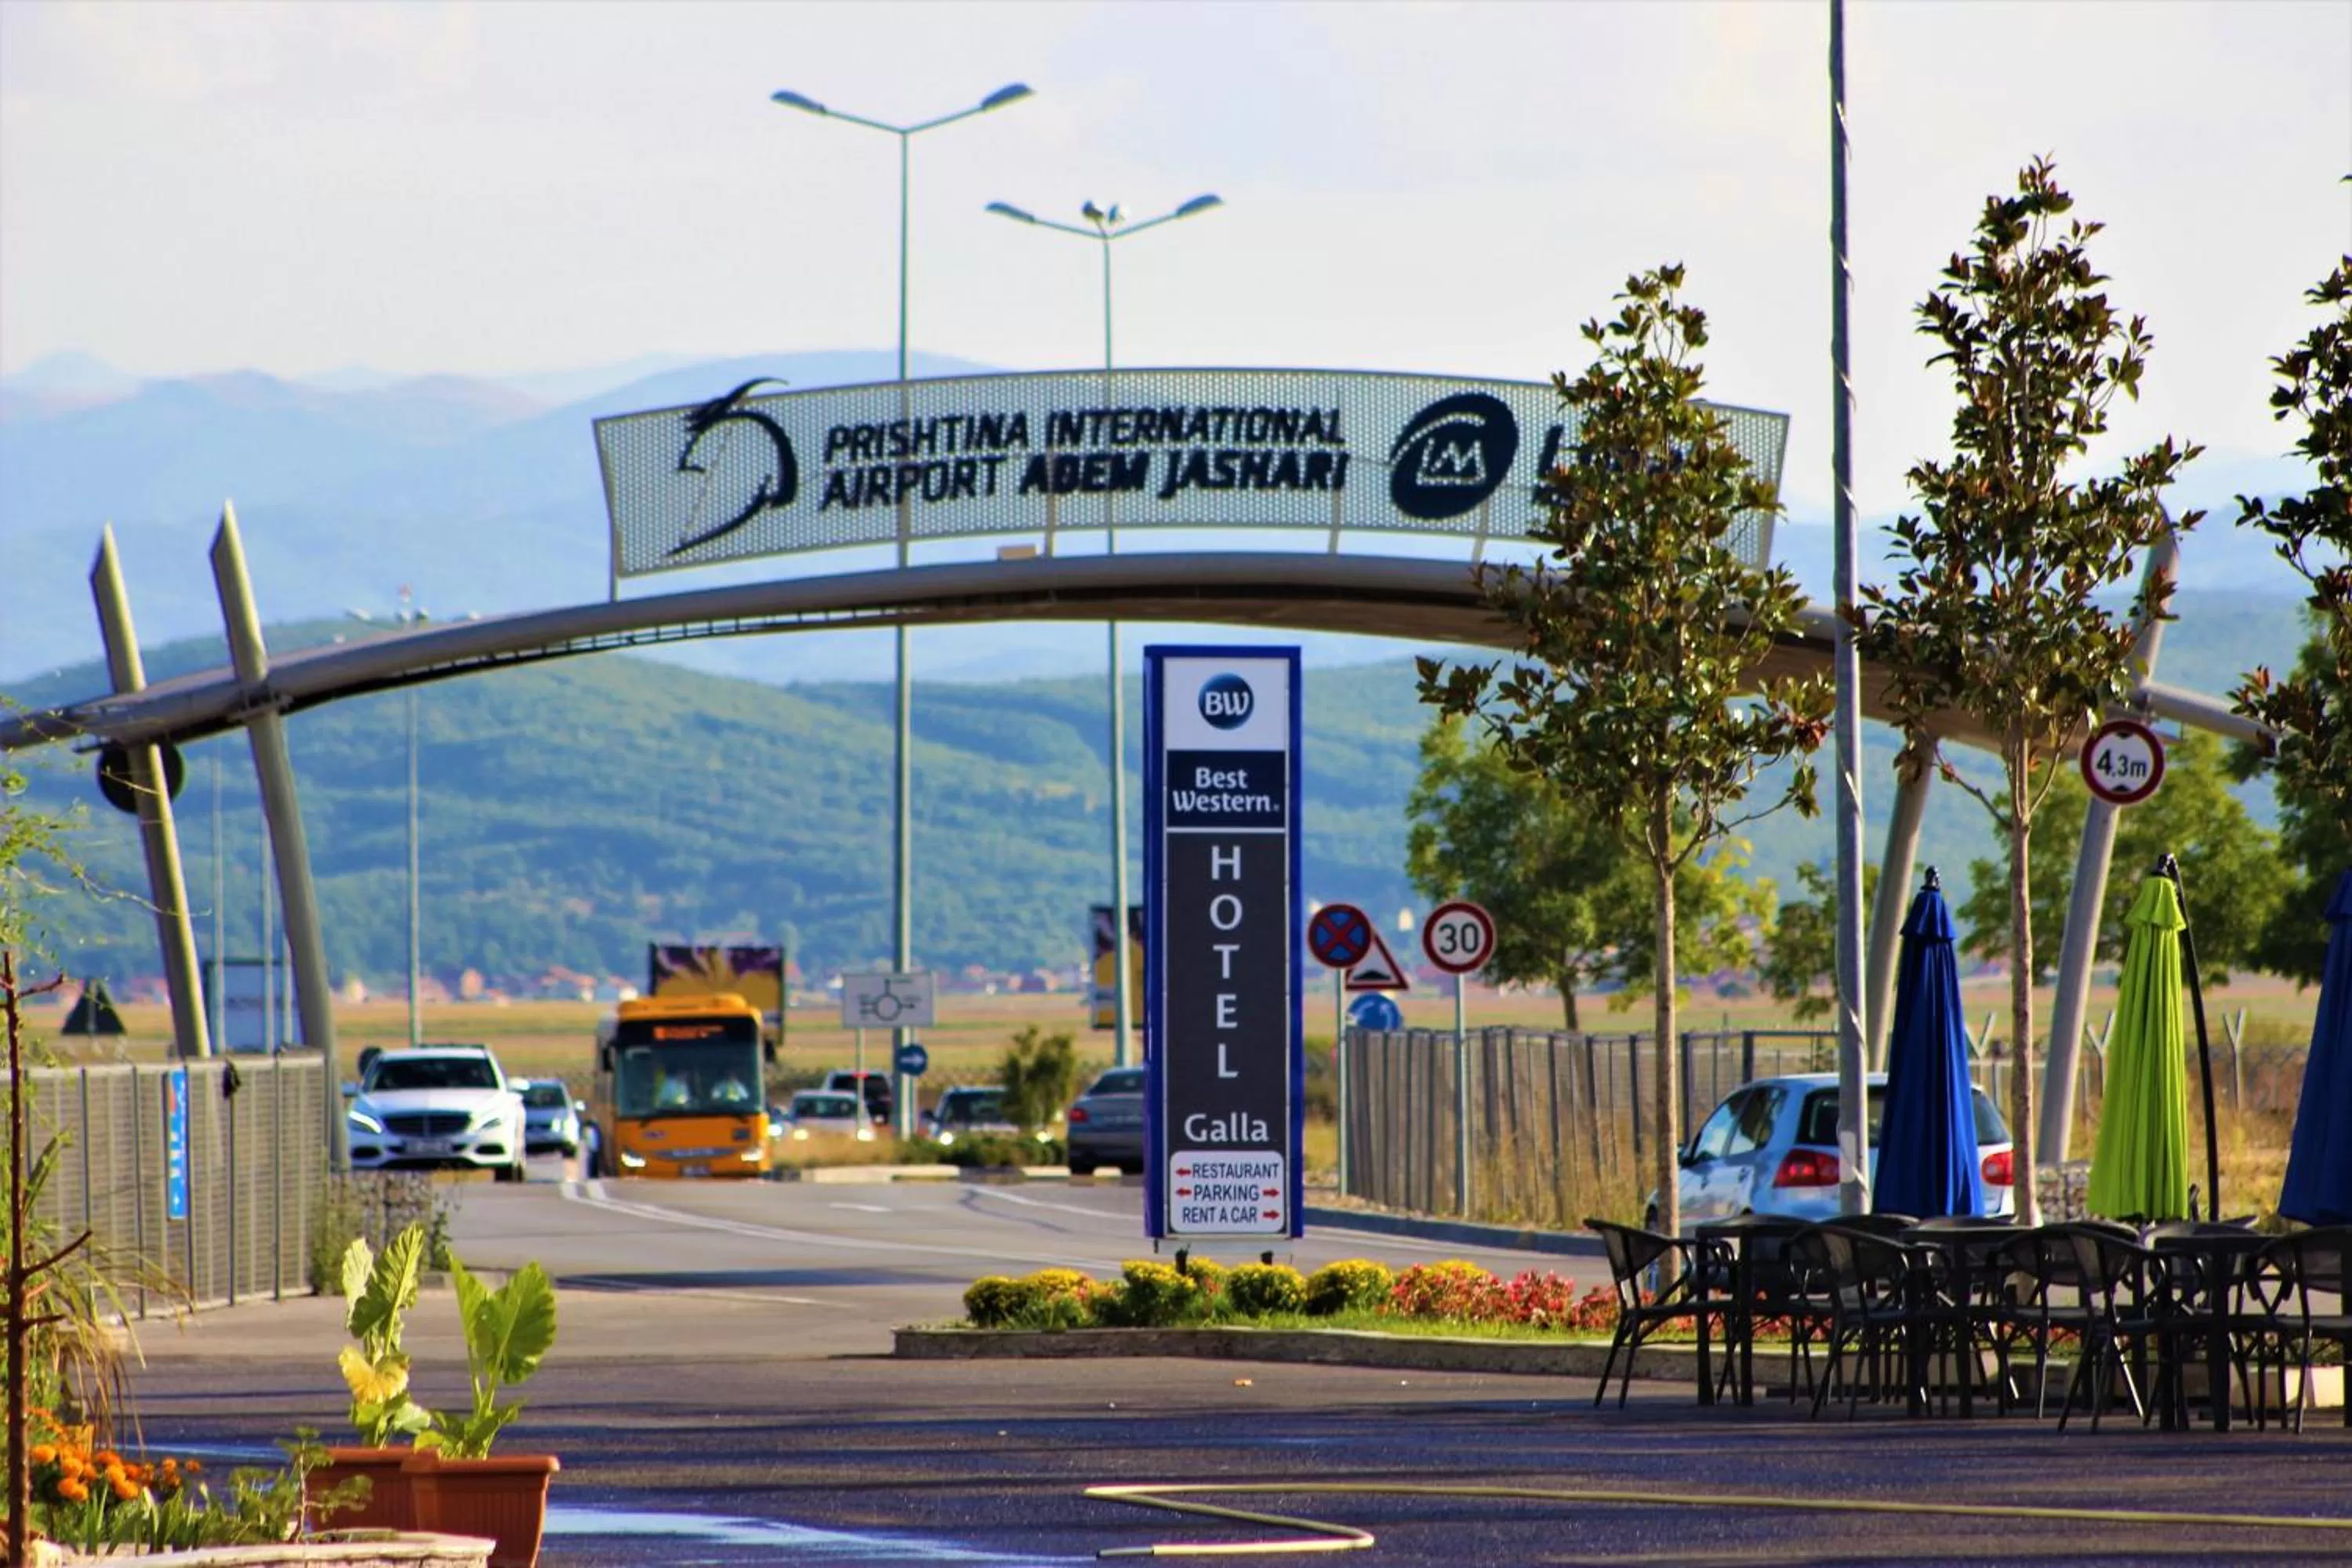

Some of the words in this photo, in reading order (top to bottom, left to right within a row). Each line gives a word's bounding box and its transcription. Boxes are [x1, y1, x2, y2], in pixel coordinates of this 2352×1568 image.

[824, 411, 1029, 463] PRISHTINA
[1047, 406, 1345, 447] INTERNATIONAL
[818, 455, 1007, 511] AIRPORT
[1019, 452, 1149, 495] ADEM
[1157, 450, 1350, 499] JASHARI
[1204, 691, 1250, 716] BW
[1195, 766, 1248, 789] Best
[1438, 922, 1479, 954] 30
[1210, 845, 1243, 1078] HOTEL
[1184, 1112, 1269, 1142] Galla
[1192, 1163, 1279, 1178] RESTAURANT
[1193, 1185, 1260, 1202] PARKING
[1182, 1207, 1218, 1223] RENT
[1219, 1207, 1229, 1223] A
[1230, 1207, 1258, 1223] CAR
